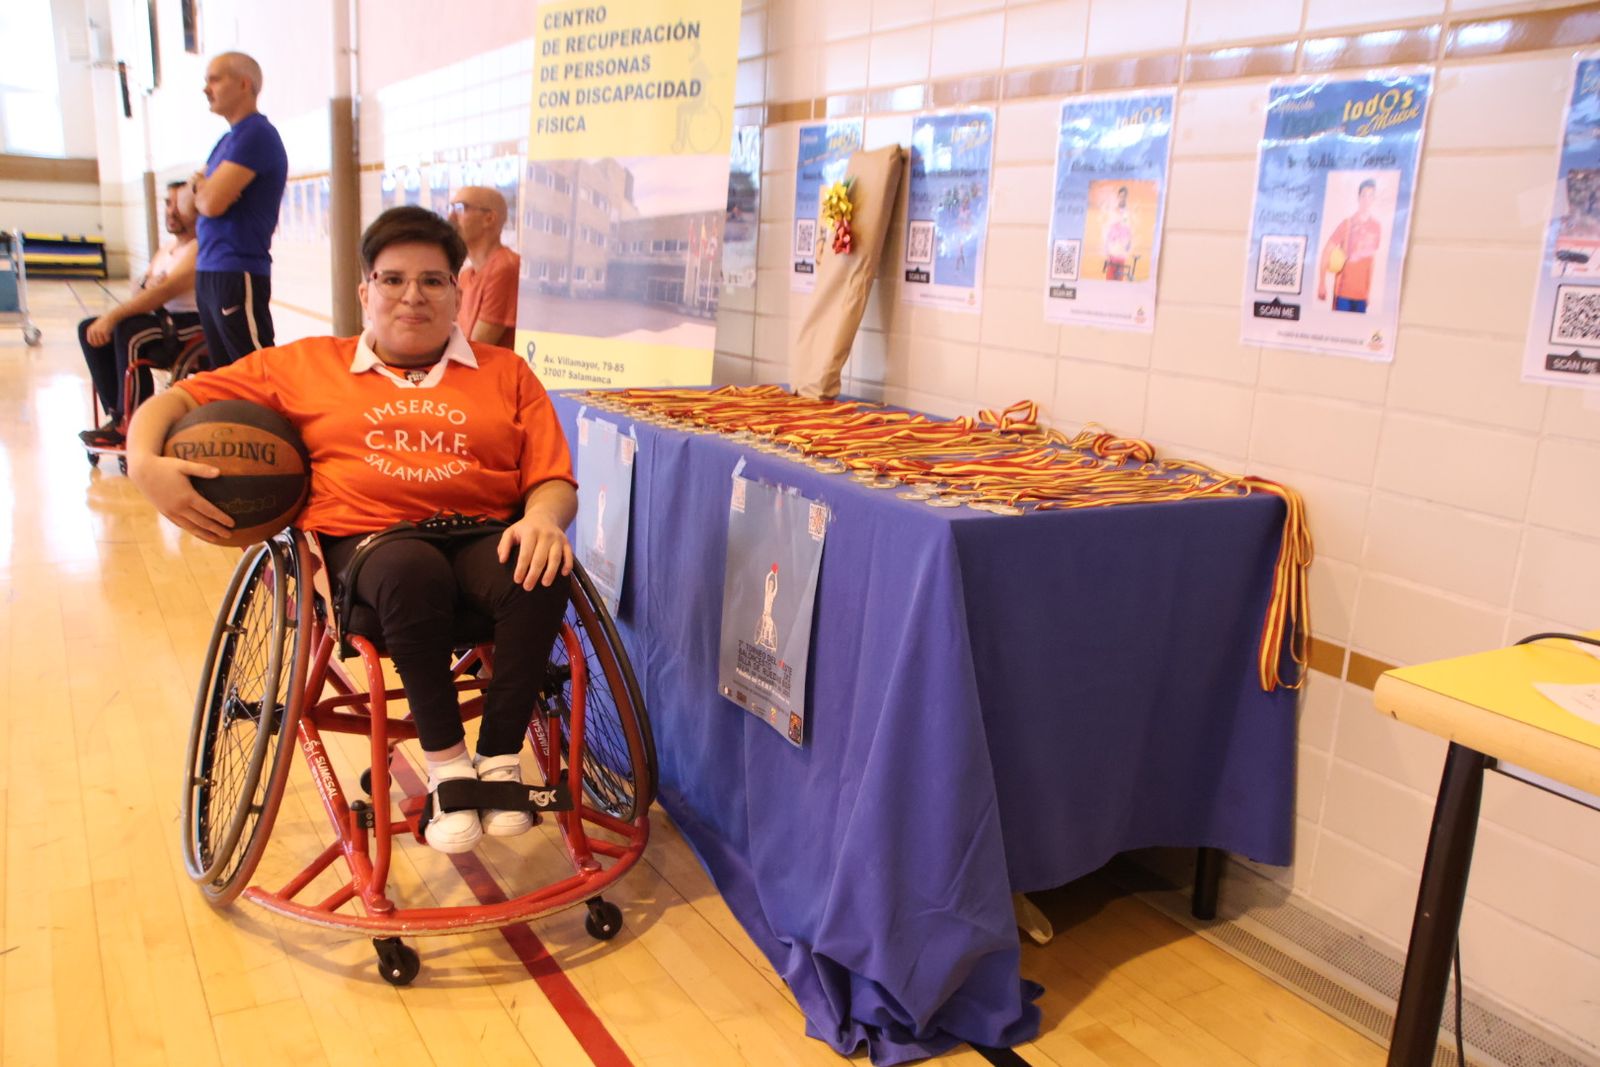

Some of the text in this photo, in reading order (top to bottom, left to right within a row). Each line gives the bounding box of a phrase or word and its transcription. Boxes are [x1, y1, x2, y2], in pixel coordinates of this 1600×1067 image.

[543, 5, 607, 30] CENTRO
[541, 18, 701, 57] DE RECUPERACIÓN
[540, 55, 651, 83] DE PERSONAS
[538, 79, 702, 109] CON DISCAPACIDAD
[537, 115, 587, 134] FÍSICA
[1260, 304, 1296, 319] SCAN ME
[543, 367, 612, 385] 37007 Salamanca
[557, 356, 601, 370] Villamayor,
[603, 361, 626, 374] 79-85
[1552, 358, 1580, 370] SCAN
[363, 399, 467, 426] IMSERSO
[172, 440, 277, 466] SPALDING
[364, 429, 468, 456] C.R.M.F.
[363, 453, 472, 483] SALAMANCA
[315, 756, 338, 800] SUMESAL
